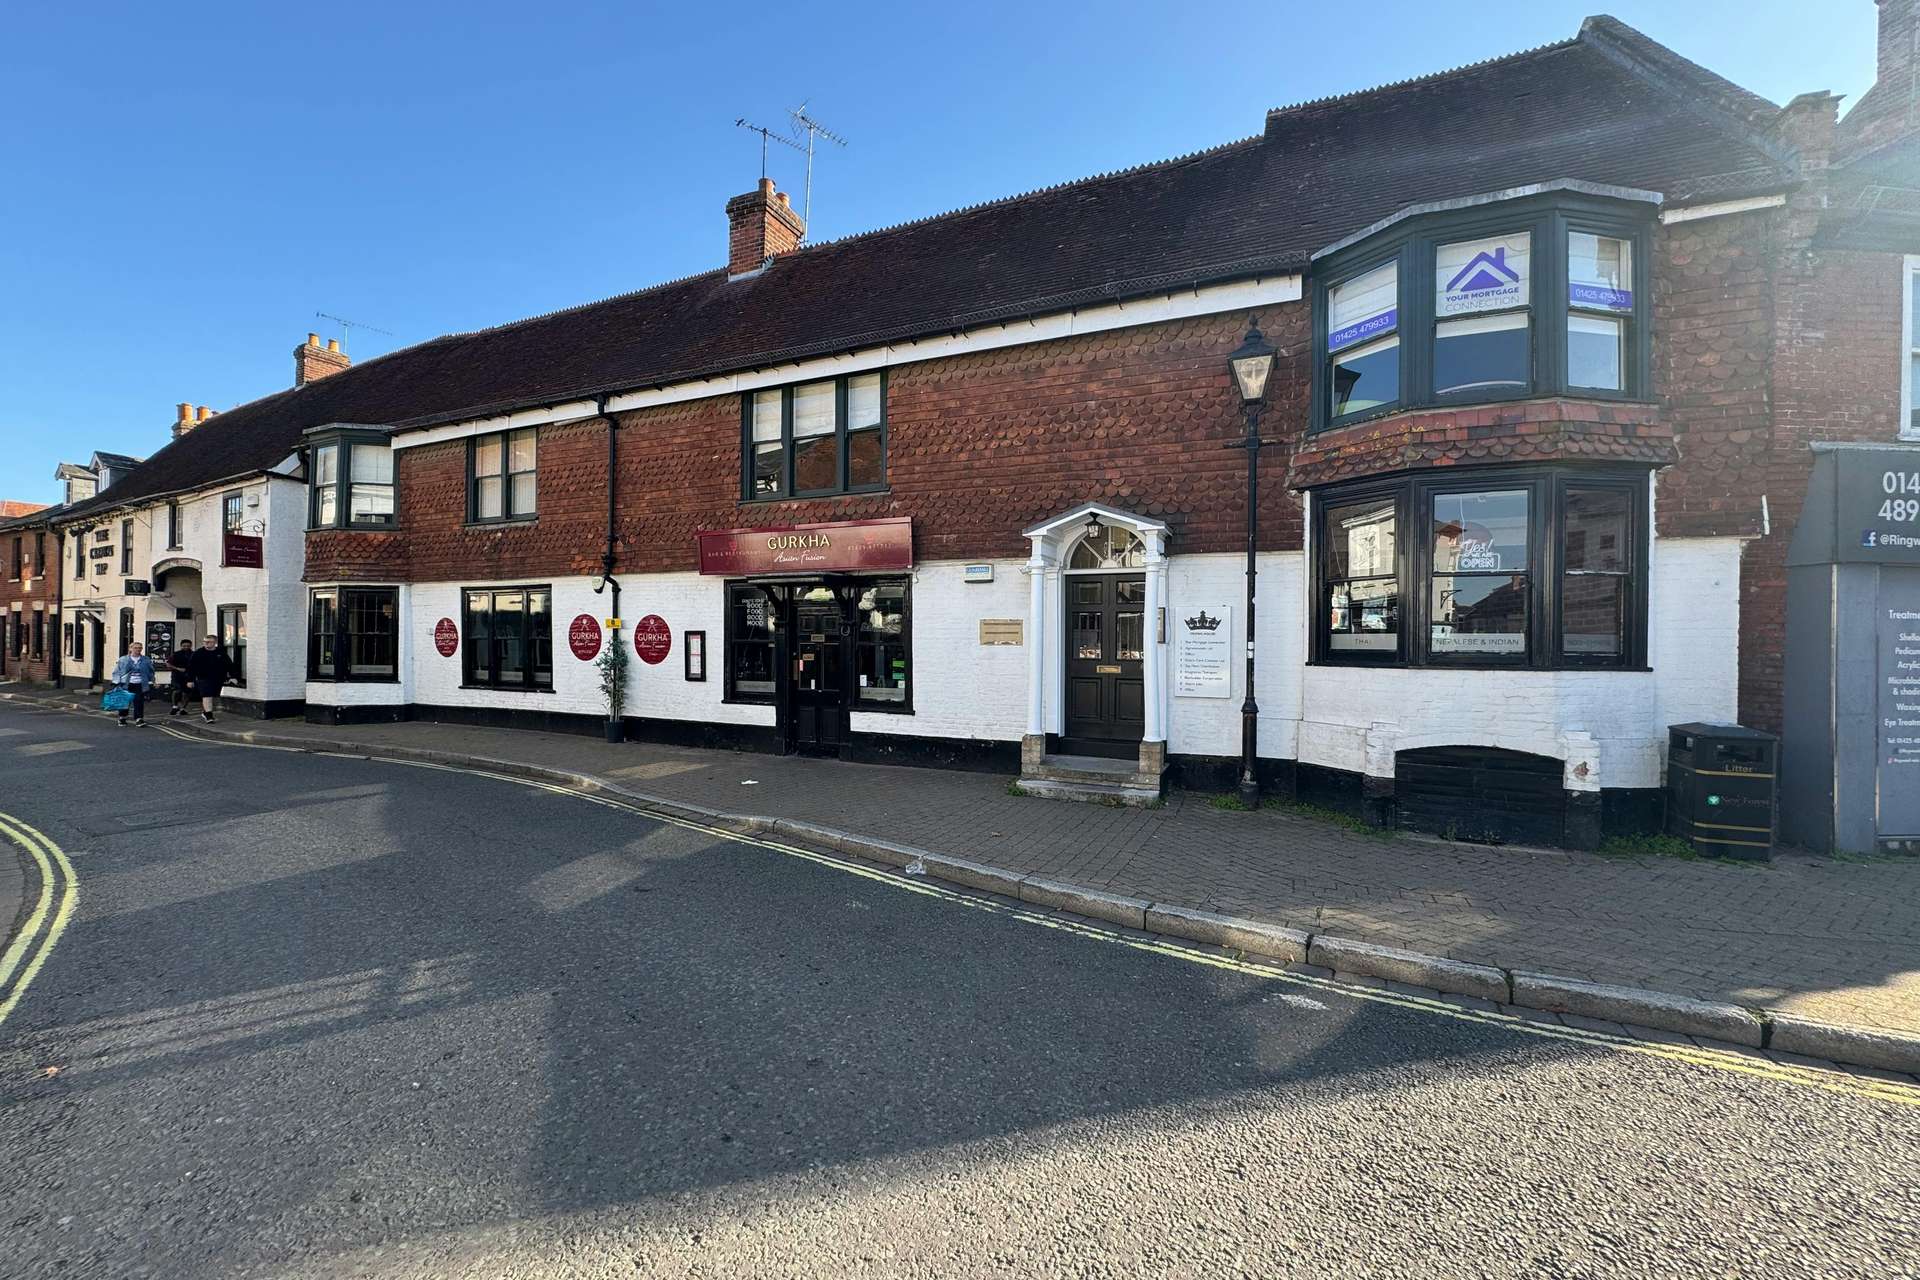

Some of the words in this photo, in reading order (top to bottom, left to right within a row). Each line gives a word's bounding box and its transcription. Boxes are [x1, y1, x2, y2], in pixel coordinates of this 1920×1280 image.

[1446, 294, 1469, 302] YOUR
[1471, 287, 1519, 298] MORTGAGE
[1576, 288, 1597, 299] 01425
[1445, 295, 1520, 312] CONNECTION
[1335, 327, 1358, 343] 01425
[1359, 315, 1389, 333] 479933
[1882, 471, 1920, 494] 014
[1877, 499, 1920, 521] 489
[767, 534, 831, 550] GURKHA
[774, 551, 800, 563] Asian
[800, 549, 826, 566] Fusion
[1461, 558, 1495, 568] OPEN
[571, 631, 599, 641] GURKHA
[637, 633, 668, 642] GURKHA
[1480, 638, 1487, 646] &
[1488, 638, 1519, 646] INDIAN
[1892, 687, 1899, 696] &
[1884, 718, 1897, 729] Eye
